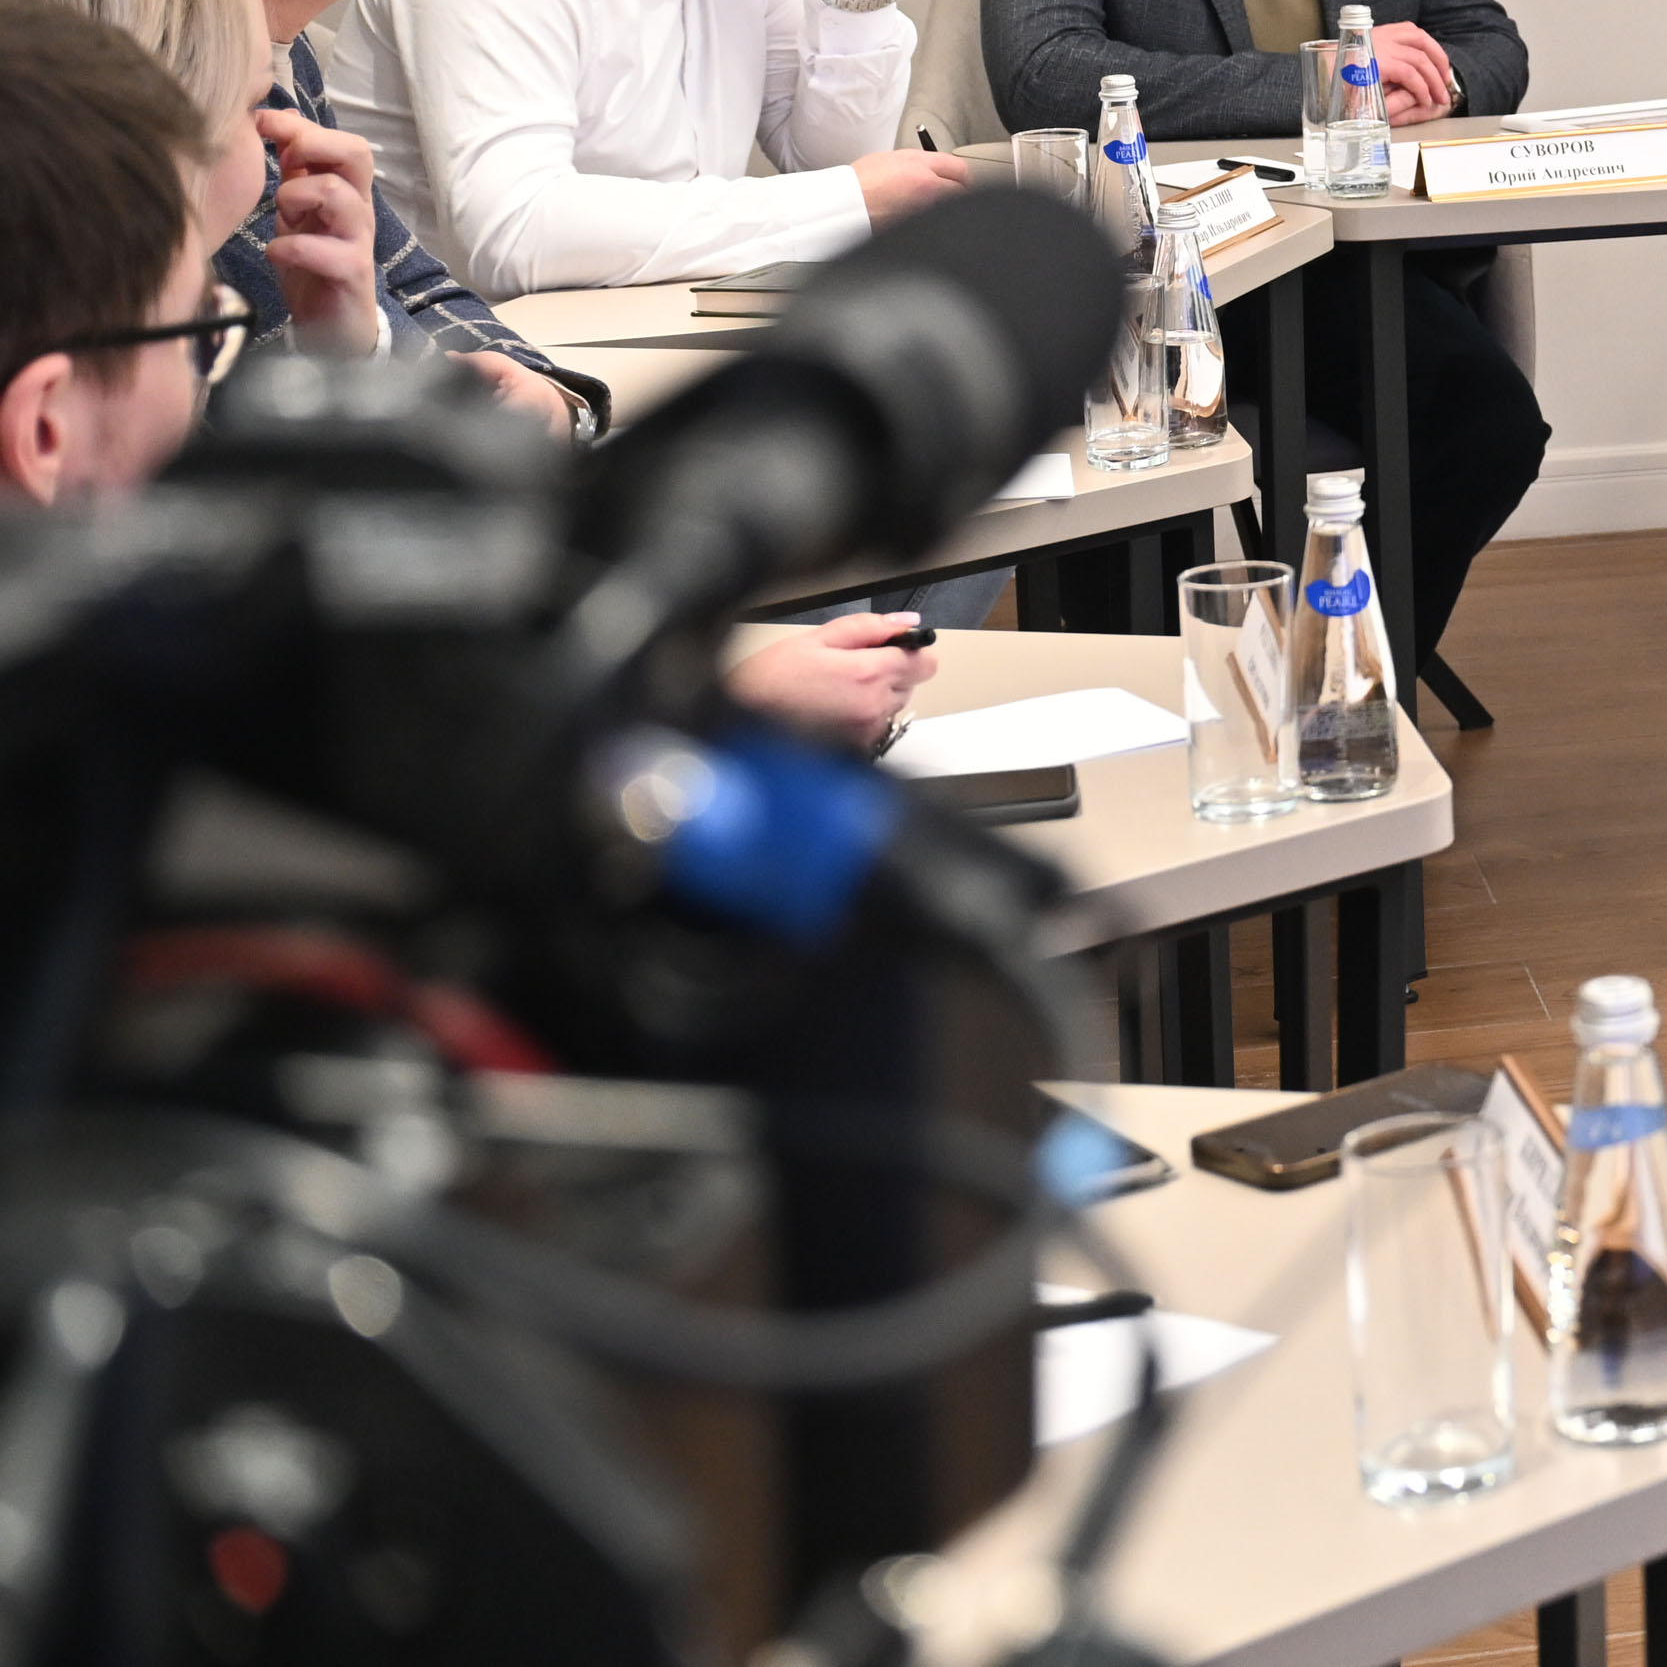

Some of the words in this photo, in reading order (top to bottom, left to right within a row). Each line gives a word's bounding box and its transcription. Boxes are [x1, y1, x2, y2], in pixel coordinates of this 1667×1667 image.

[1510, 140, 1595, 158] СУВОРОВ
[1488, 168, 1536, 186] Юрий
[1542, 164, 1625, 181] Андреевич
[1209, 210, 1252, 238] Ильдарович
